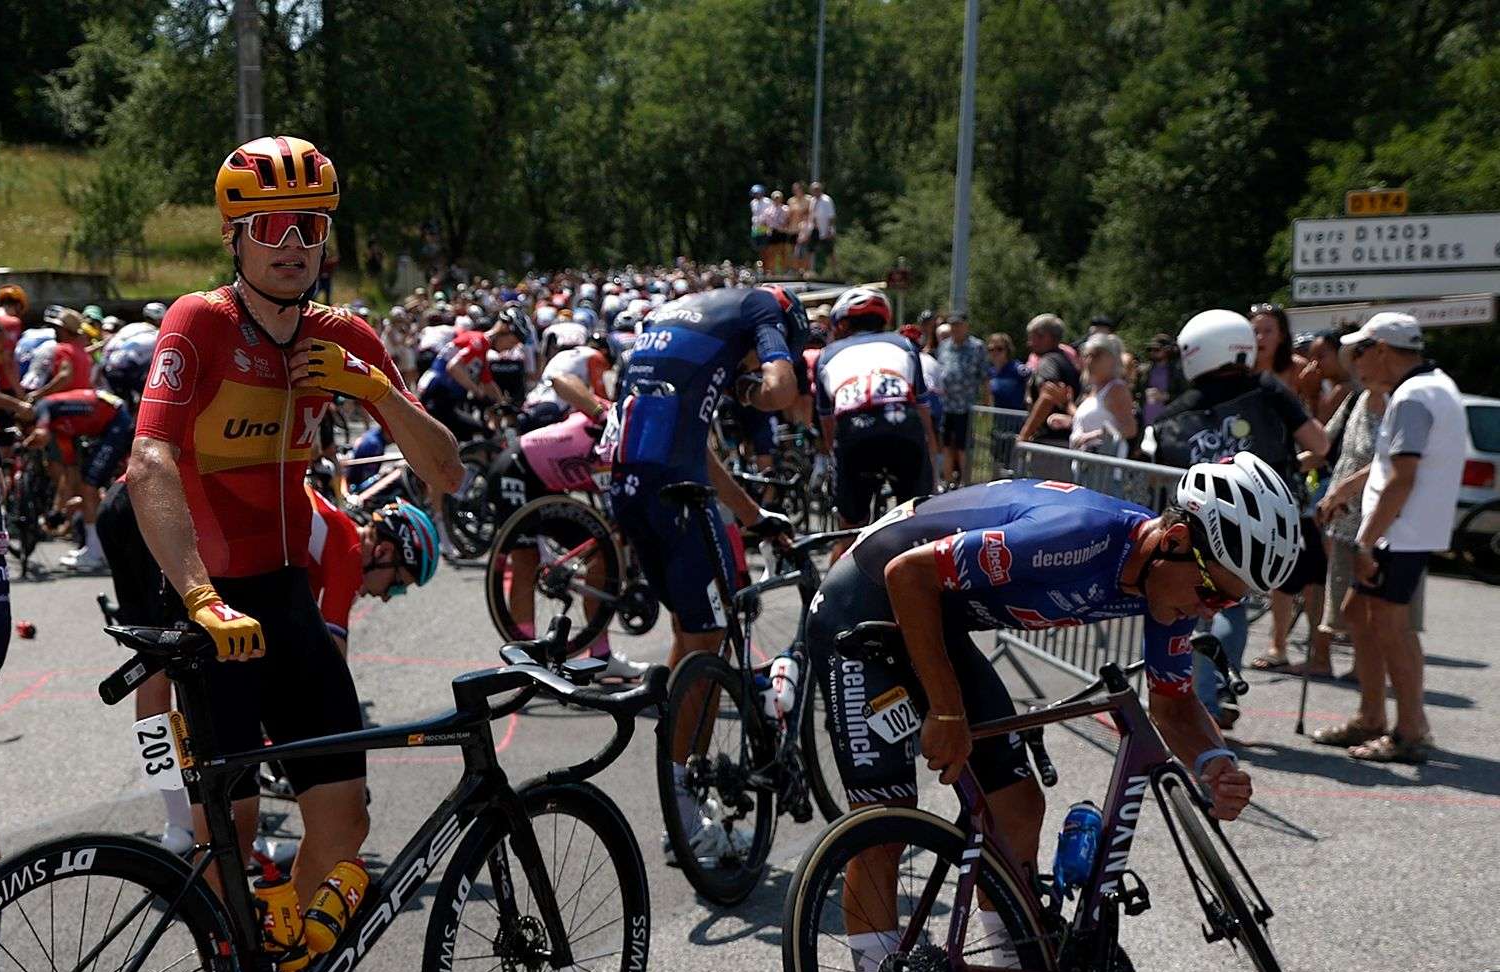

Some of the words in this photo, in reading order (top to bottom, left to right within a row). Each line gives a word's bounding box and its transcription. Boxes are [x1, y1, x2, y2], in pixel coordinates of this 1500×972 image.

[1300, 248, 1341, 265] LES
[1351, 242, 1465, 263] OLLIÈRES
[1303, 230, 1345, 243] vers
[149, 349, 186, 391] R
[223, 418, 281, 440] Uno
[1207, 508, 1225, 561] CANYON
[987, 536, 1006, 584] Alpecin
[882, 701, 917, 738] 102
[137, 725, 176, 776] 203
[54, 847, 97, 876] DT
